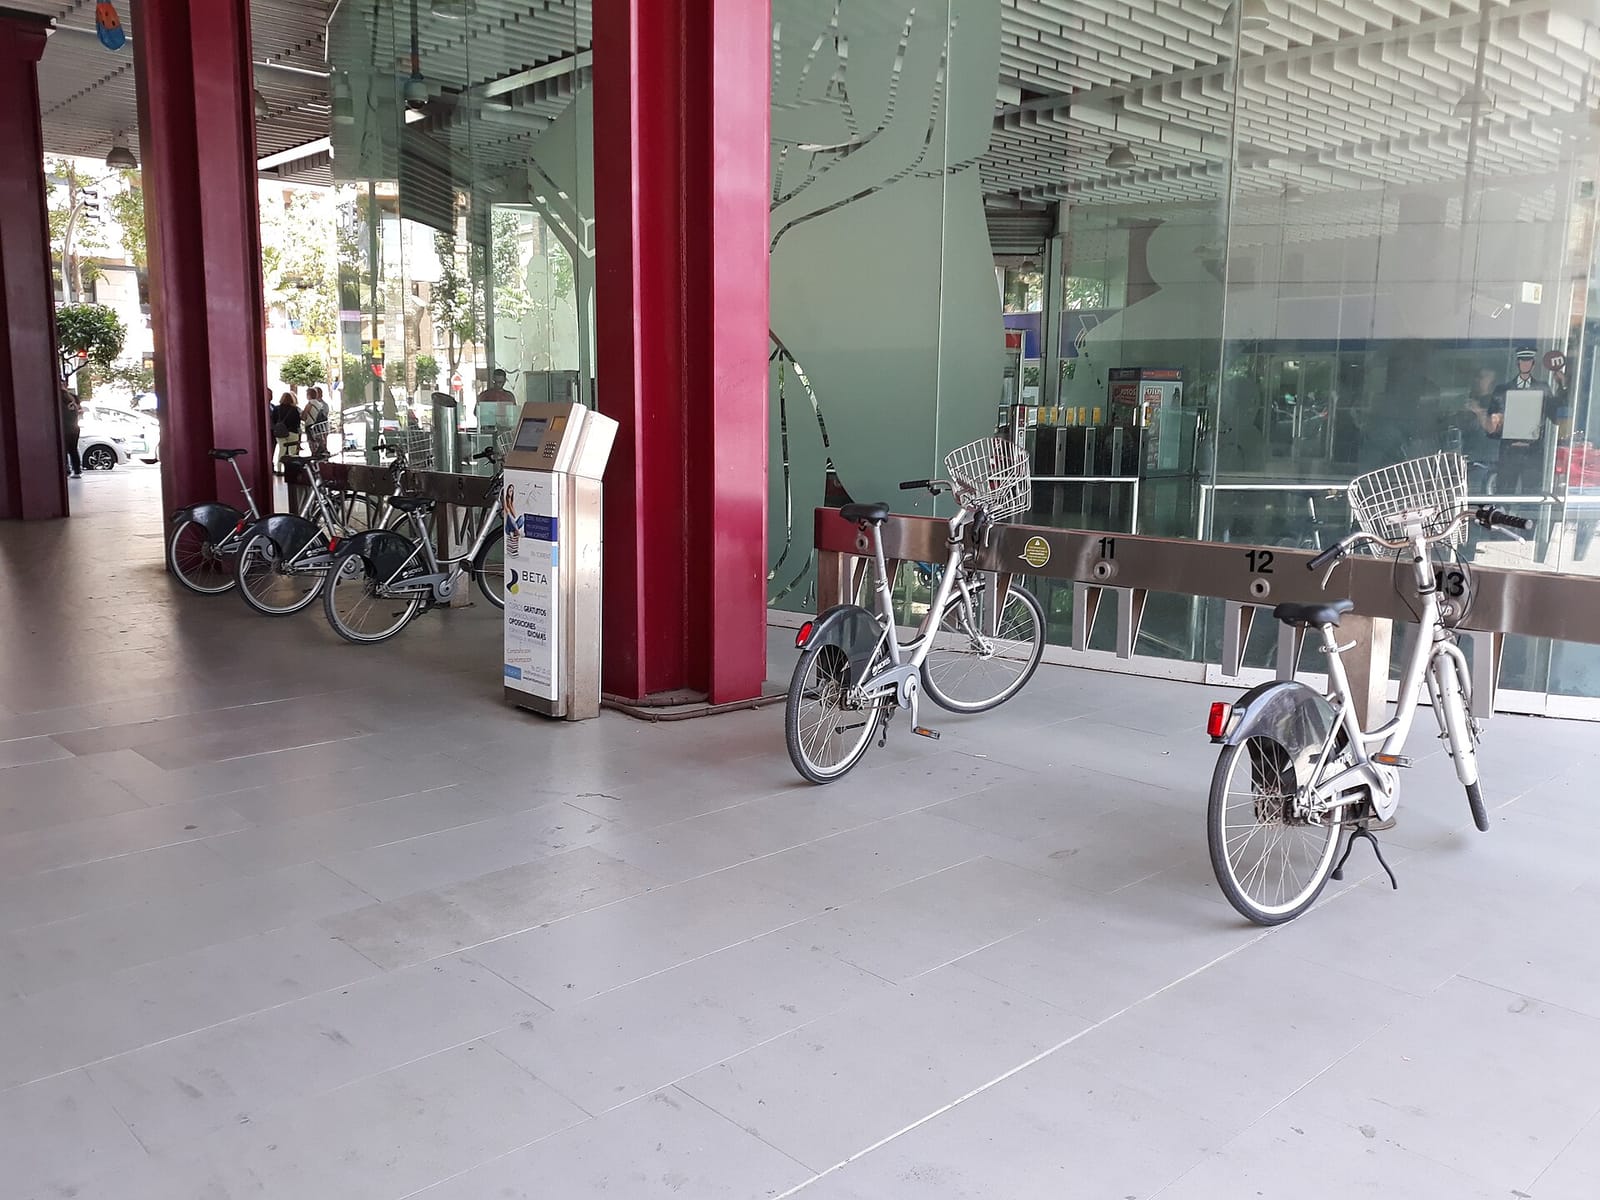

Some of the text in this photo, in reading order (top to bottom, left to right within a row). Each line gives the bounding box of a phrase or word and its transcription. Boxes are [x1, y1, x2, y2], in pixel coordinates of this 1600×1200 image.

[1099, 537, 1115, 559] 11
[1245, 550, 1274, 573] 12
[522, 570, 548, 585] BETA
[1435, 571, 1465, 597] 13
